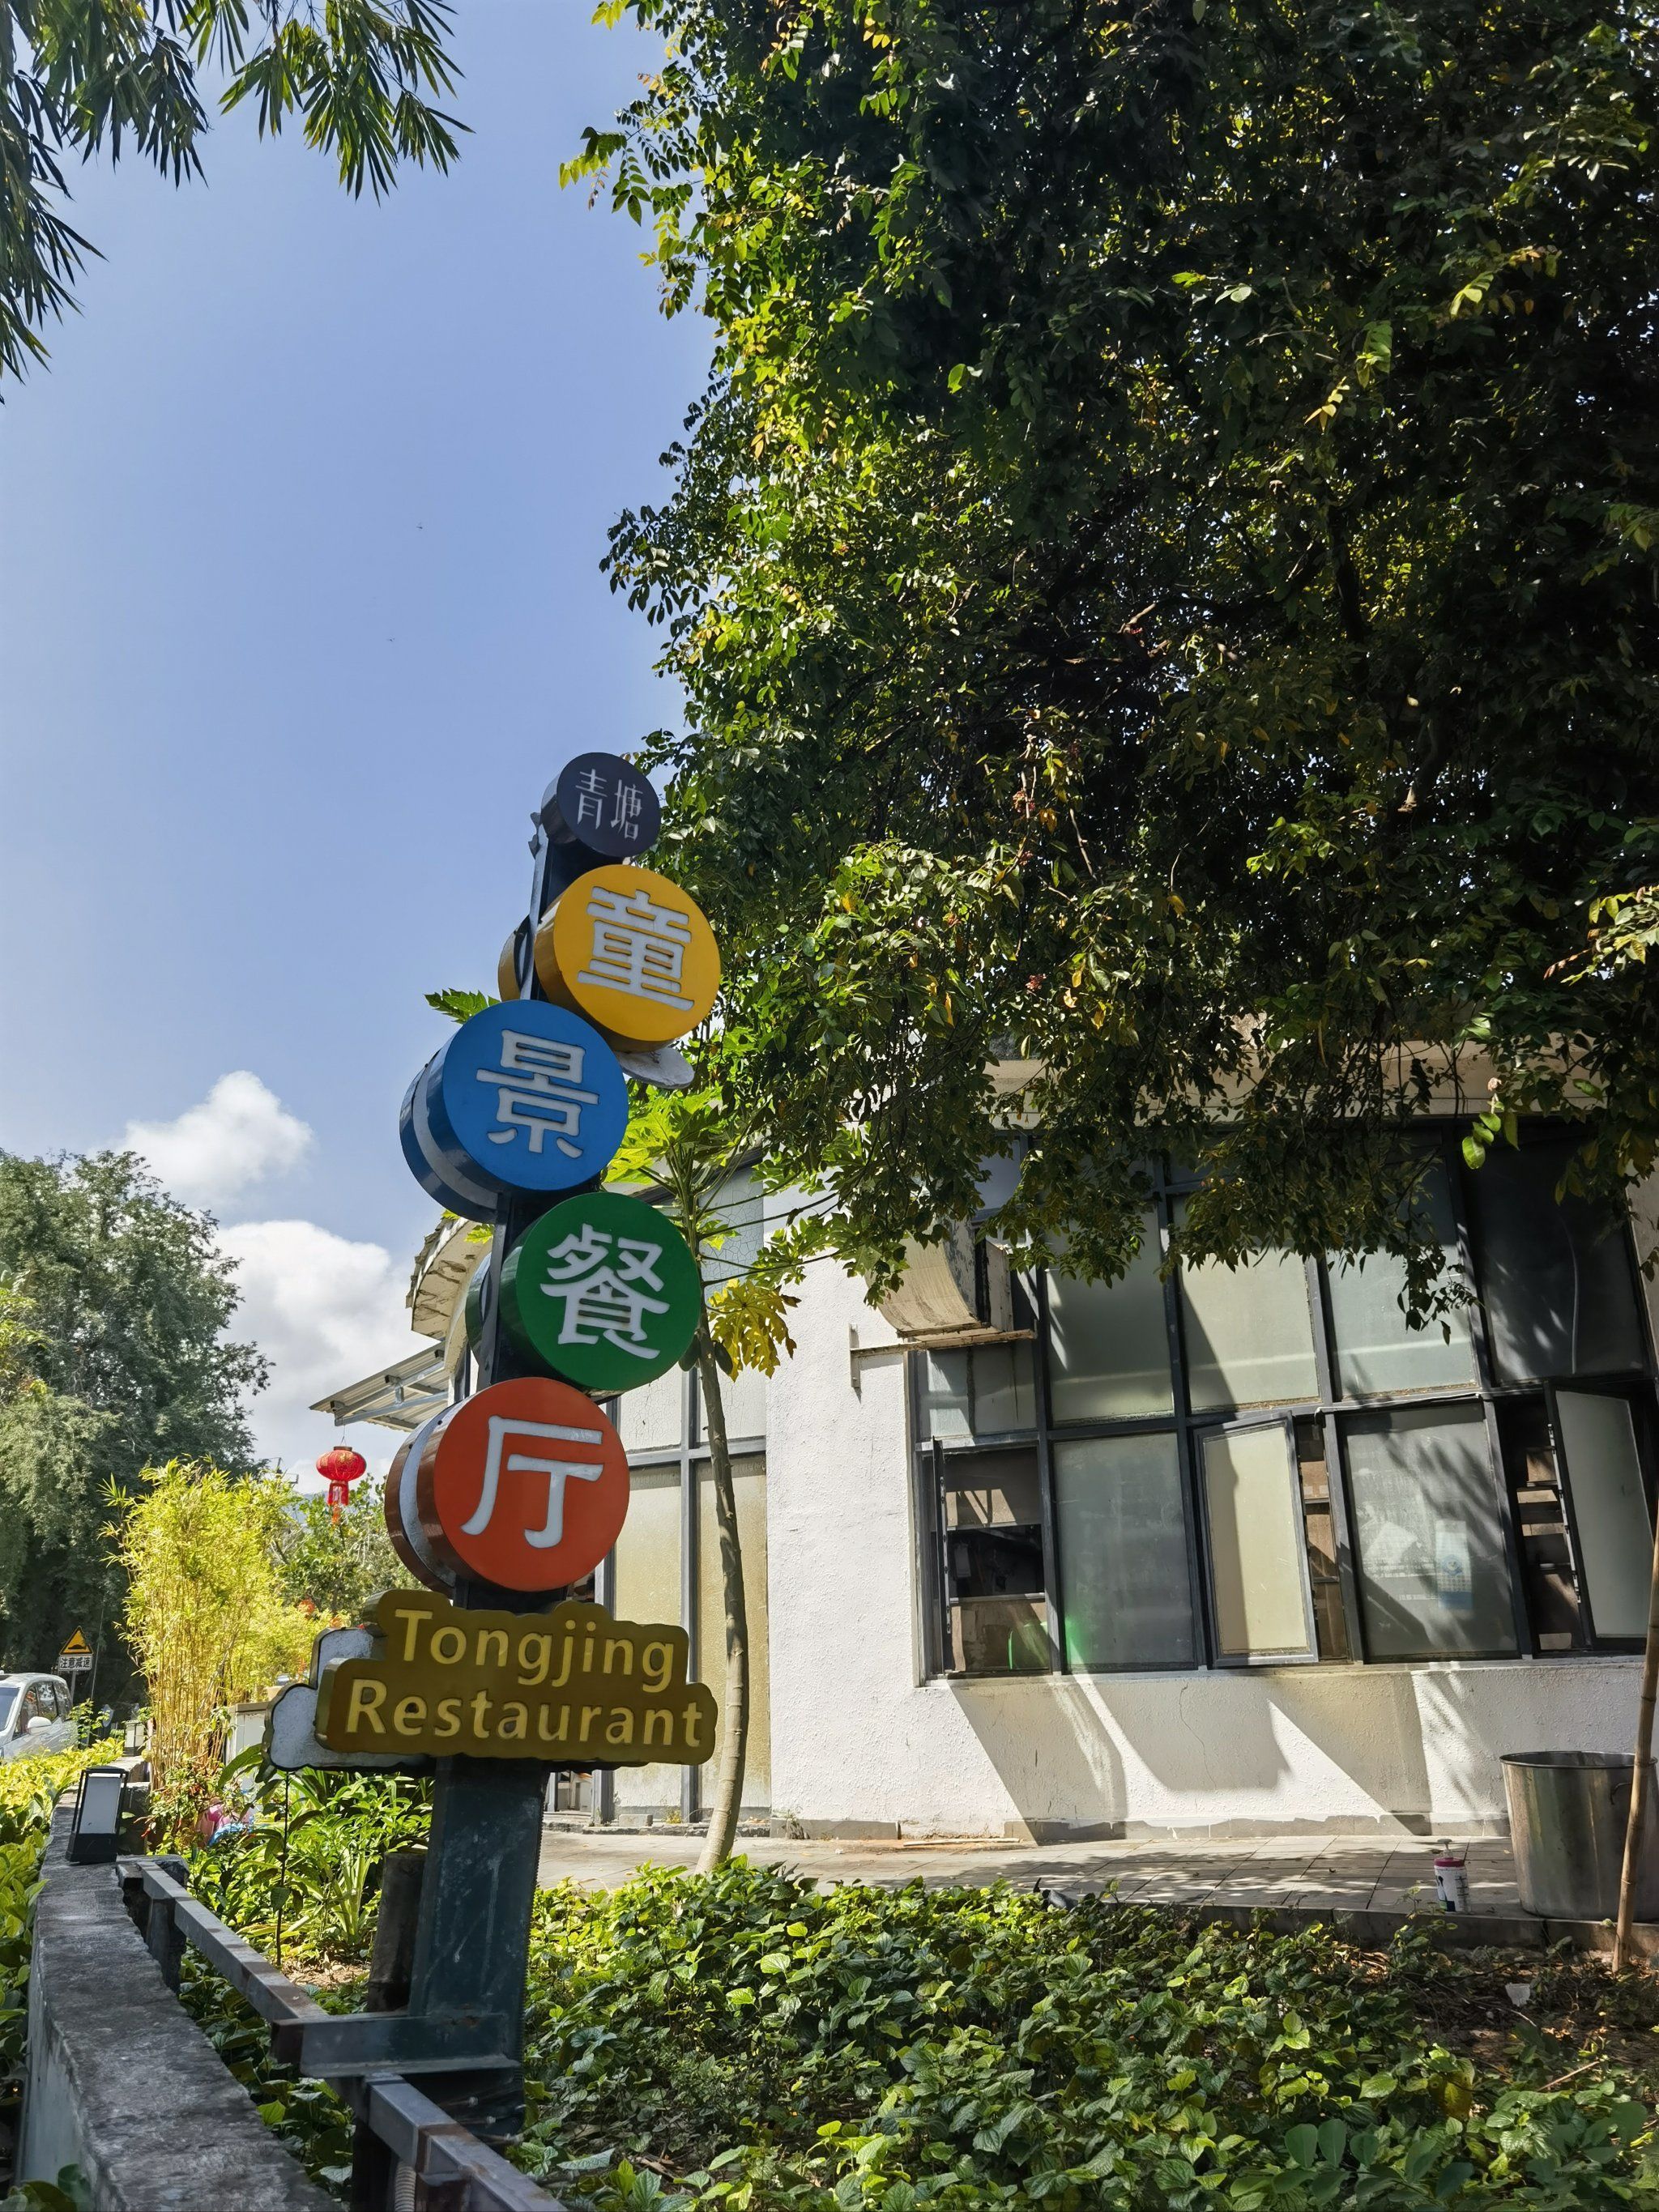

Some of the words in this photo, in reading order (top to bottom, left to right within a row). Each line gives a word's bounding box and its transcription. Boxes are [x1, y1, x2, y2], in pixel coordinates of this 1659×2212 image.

[575, 769, 643, 841] 青塘
[60, 1656, 91, 1669] 注意减速
[394, 1609, 674, 1693] Tongjing
[345, 1678, 703, 1748] Restaurant
